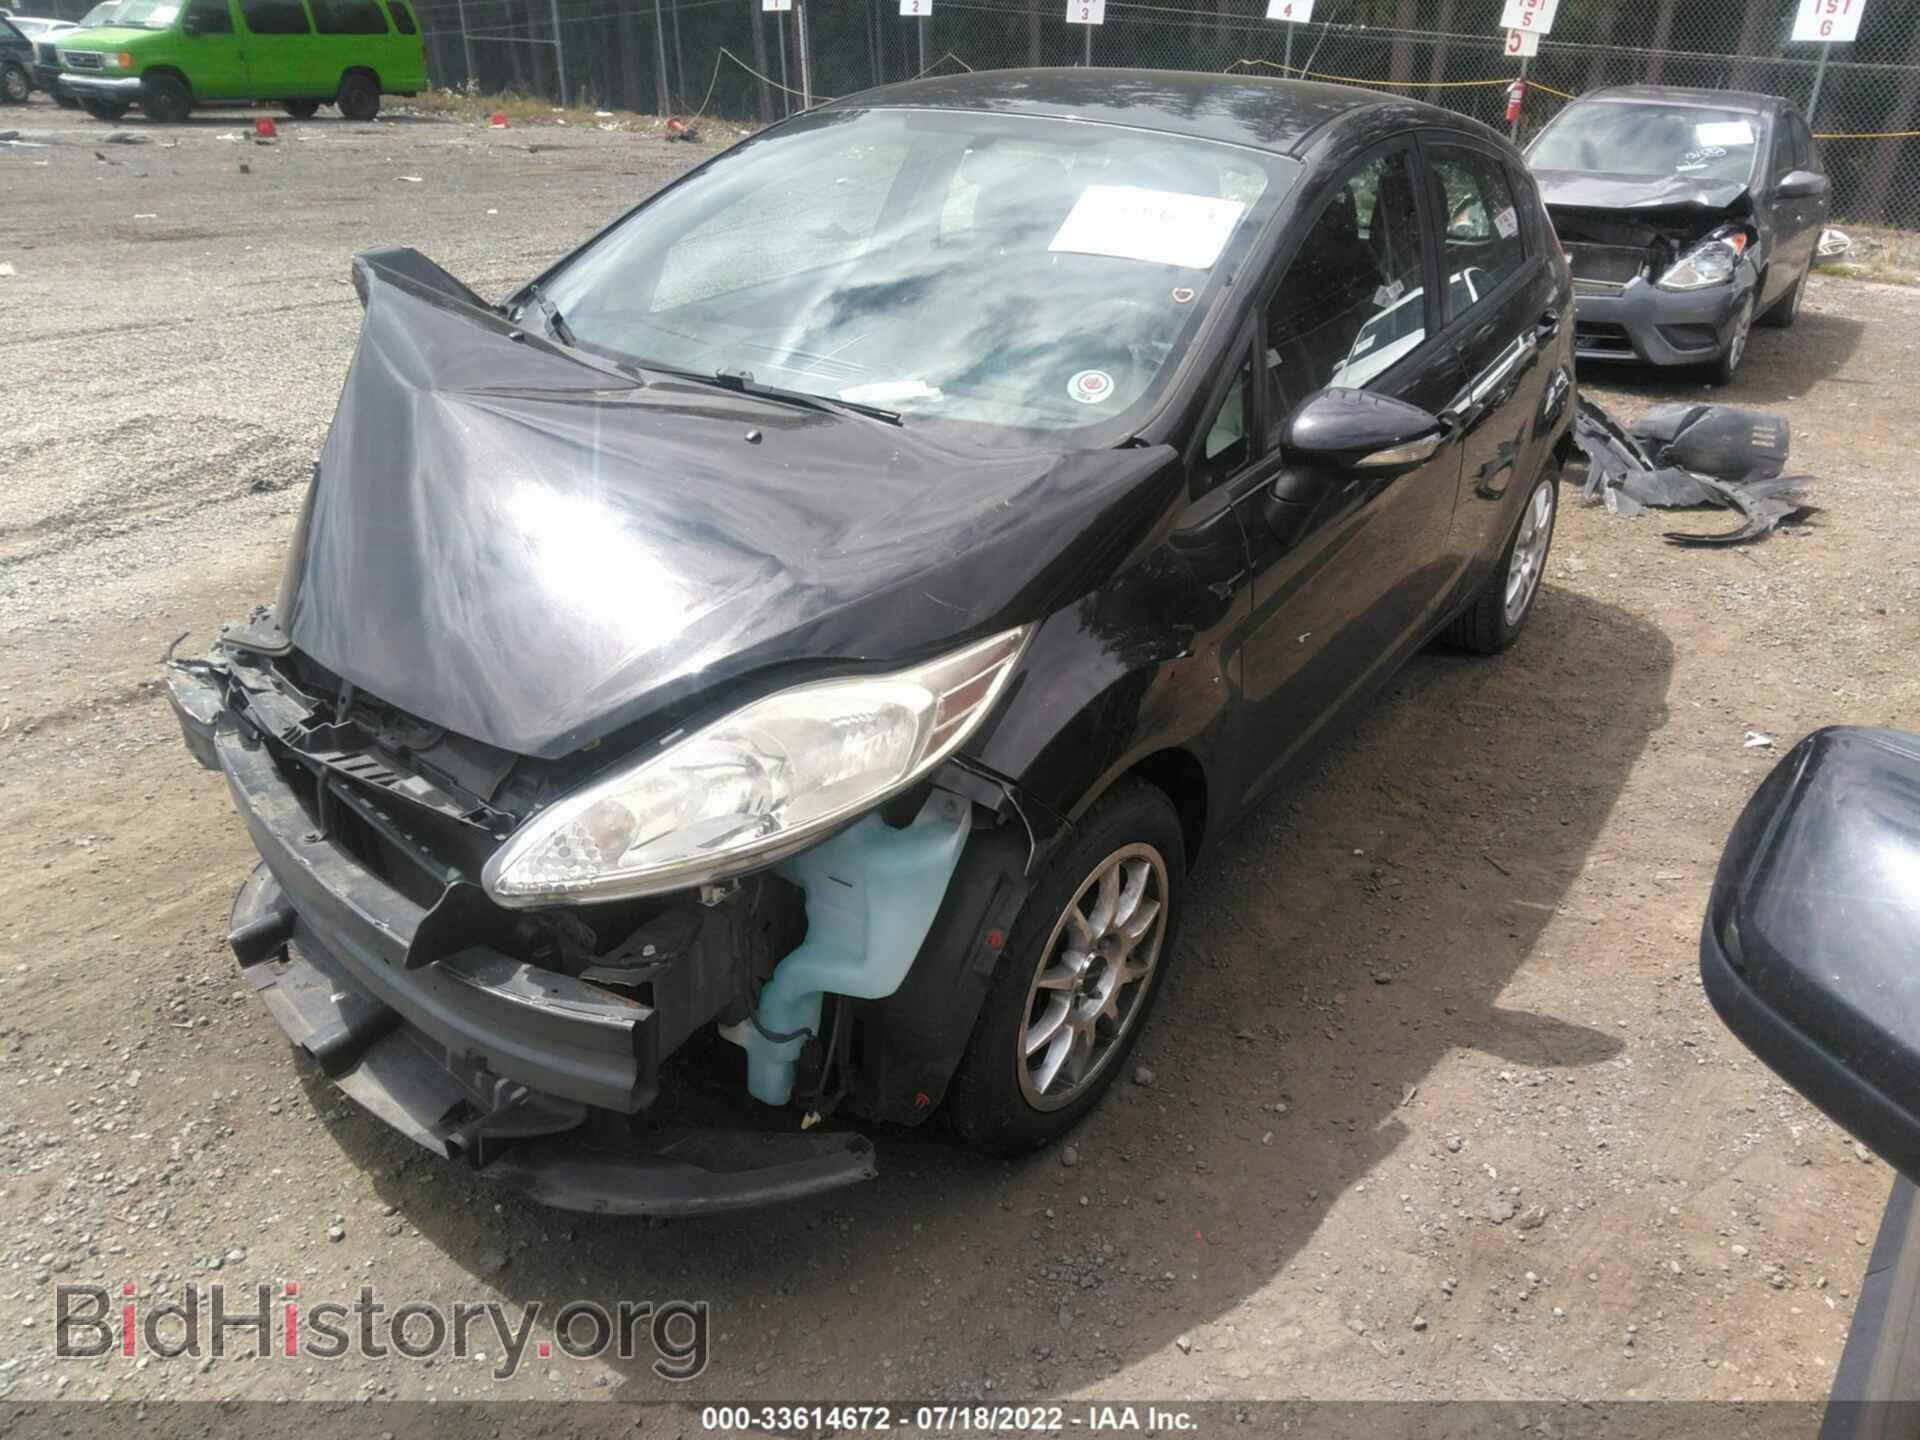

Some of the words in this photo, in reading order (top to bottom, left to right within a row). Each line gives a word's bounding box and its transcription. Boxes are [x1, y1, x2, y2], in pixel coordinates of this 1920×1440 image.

[912, 0, 920, 13] 2
[1081, 7, 1089, 20] 3
[1283, 3, 1292, 17] 4
[1522, 11, 1533, 26] 5
[1820, 19, 1833, 36] 6
